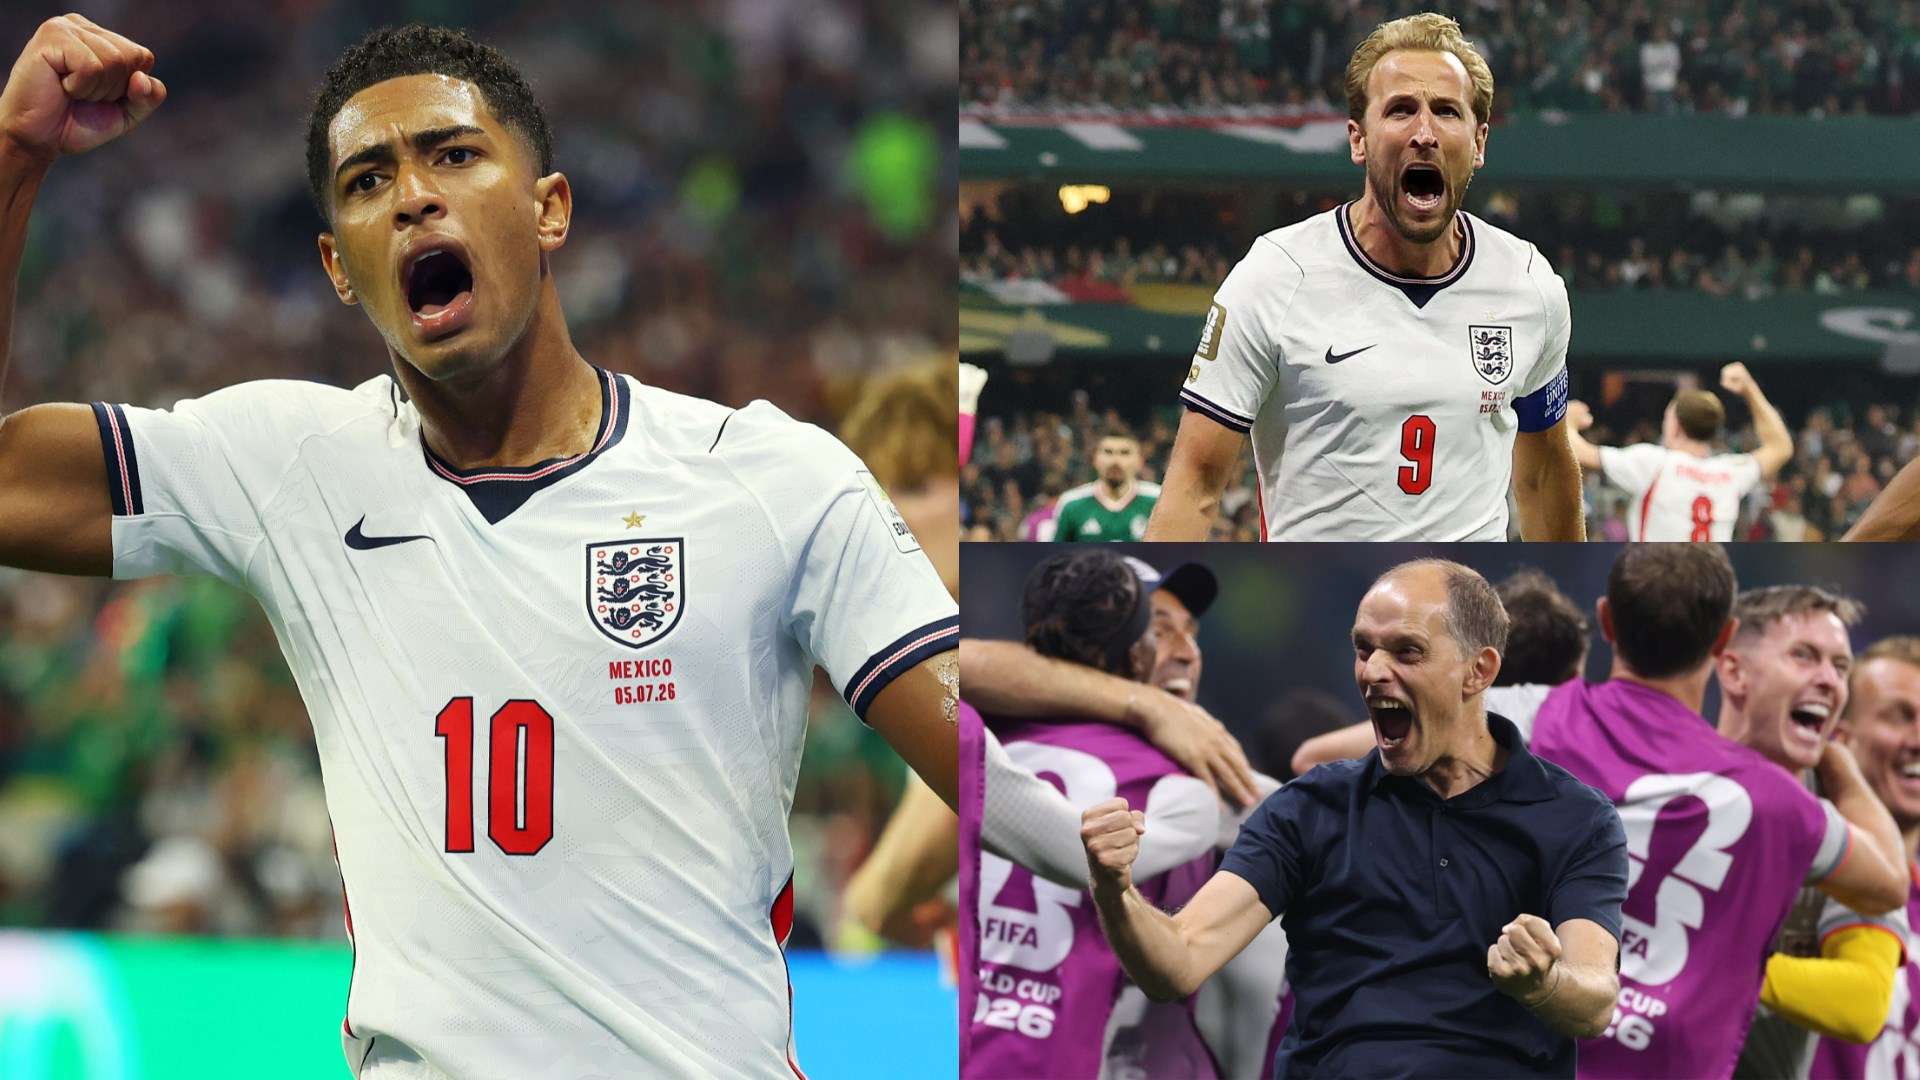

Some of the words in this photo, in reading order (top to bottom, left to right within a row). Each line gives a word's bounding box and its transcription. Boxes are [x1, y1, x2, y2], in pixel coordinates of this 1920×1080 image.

[1481, 391, 1506, 401] MEXICO
[1397, 414, 1437, 496] 9
[1692, 495, 1713, 541] 8
[608, 658, 673, 680] MEXICO
[615, 683, 676, 705] 05.07.26
[434, 696, 555, 857] 10
[984, 918, 1039, 949] FIFA
[1621, 928, 1649, 960] FA
[979, 968, 1015, 994] LD
[1017, 978, 1062, 1005] CUP
[1617, 986, 1668, 1018] CUP
